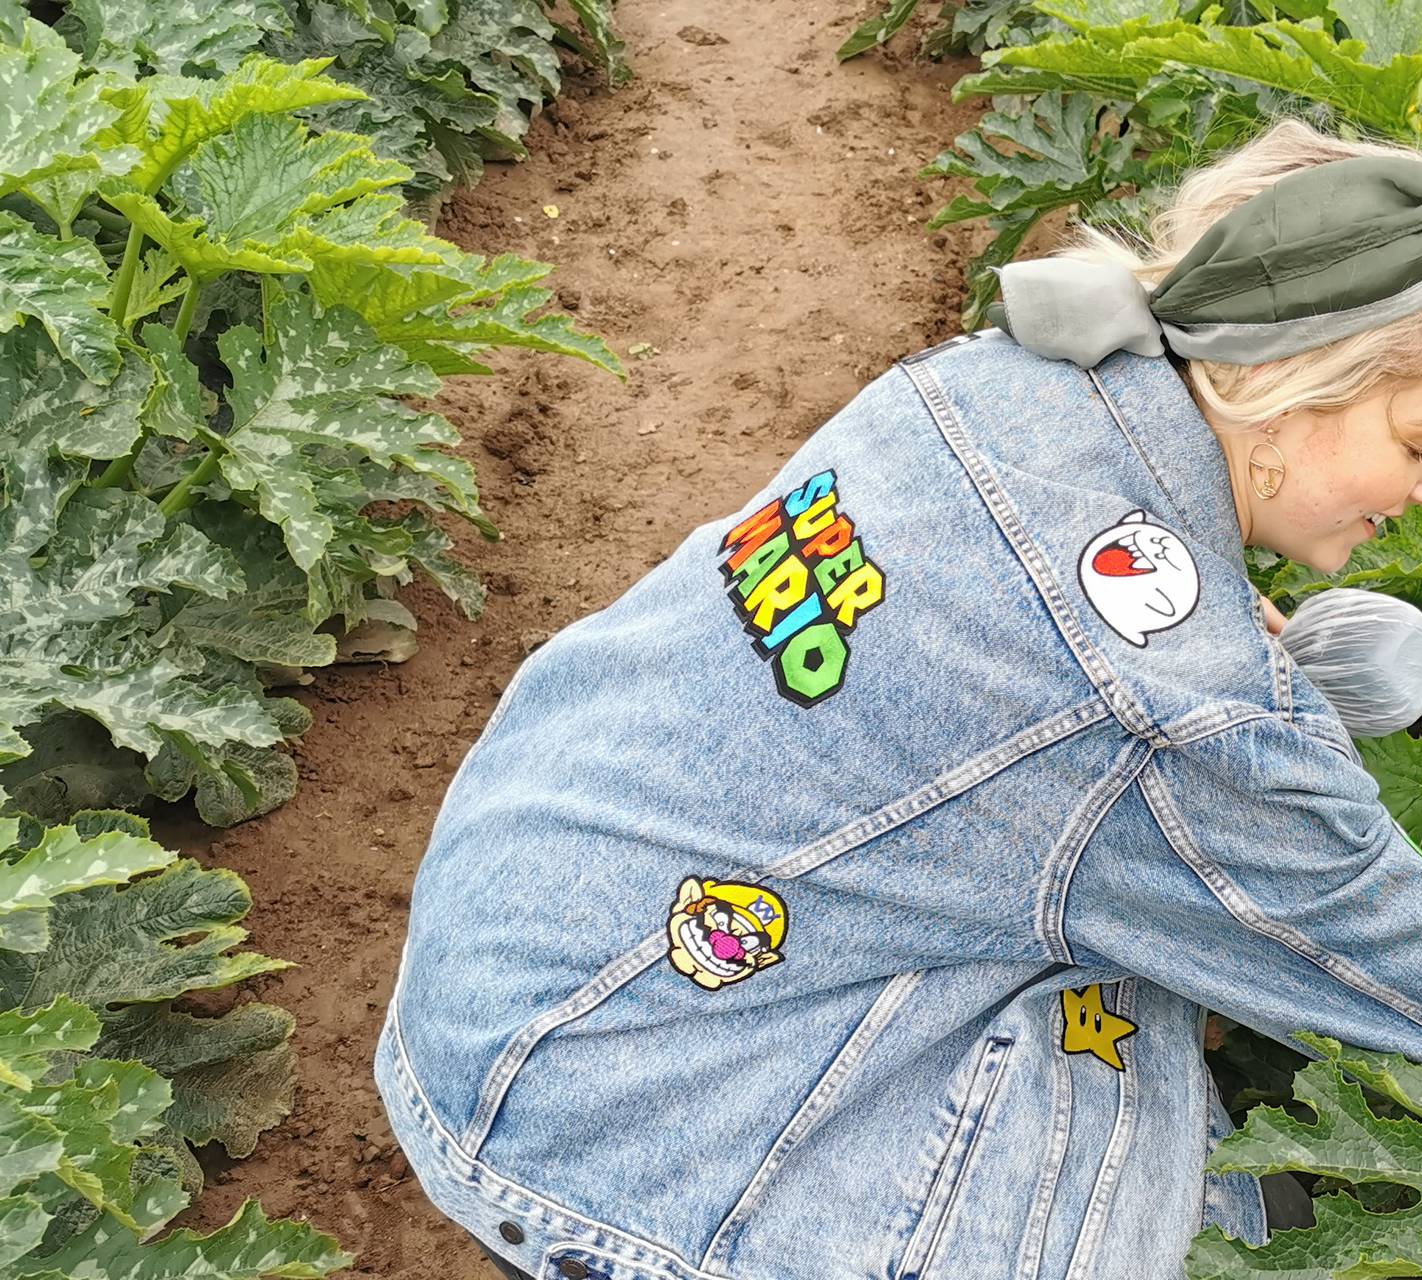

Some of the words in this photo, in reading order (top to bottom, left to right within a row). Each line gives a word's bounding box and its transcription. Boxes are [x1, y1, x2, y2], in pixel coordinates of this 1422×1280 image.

[722, 499, 849, 701] MARIO
[783, 470, 884, 628] SUPER
[753, 894, 781, 922] W
